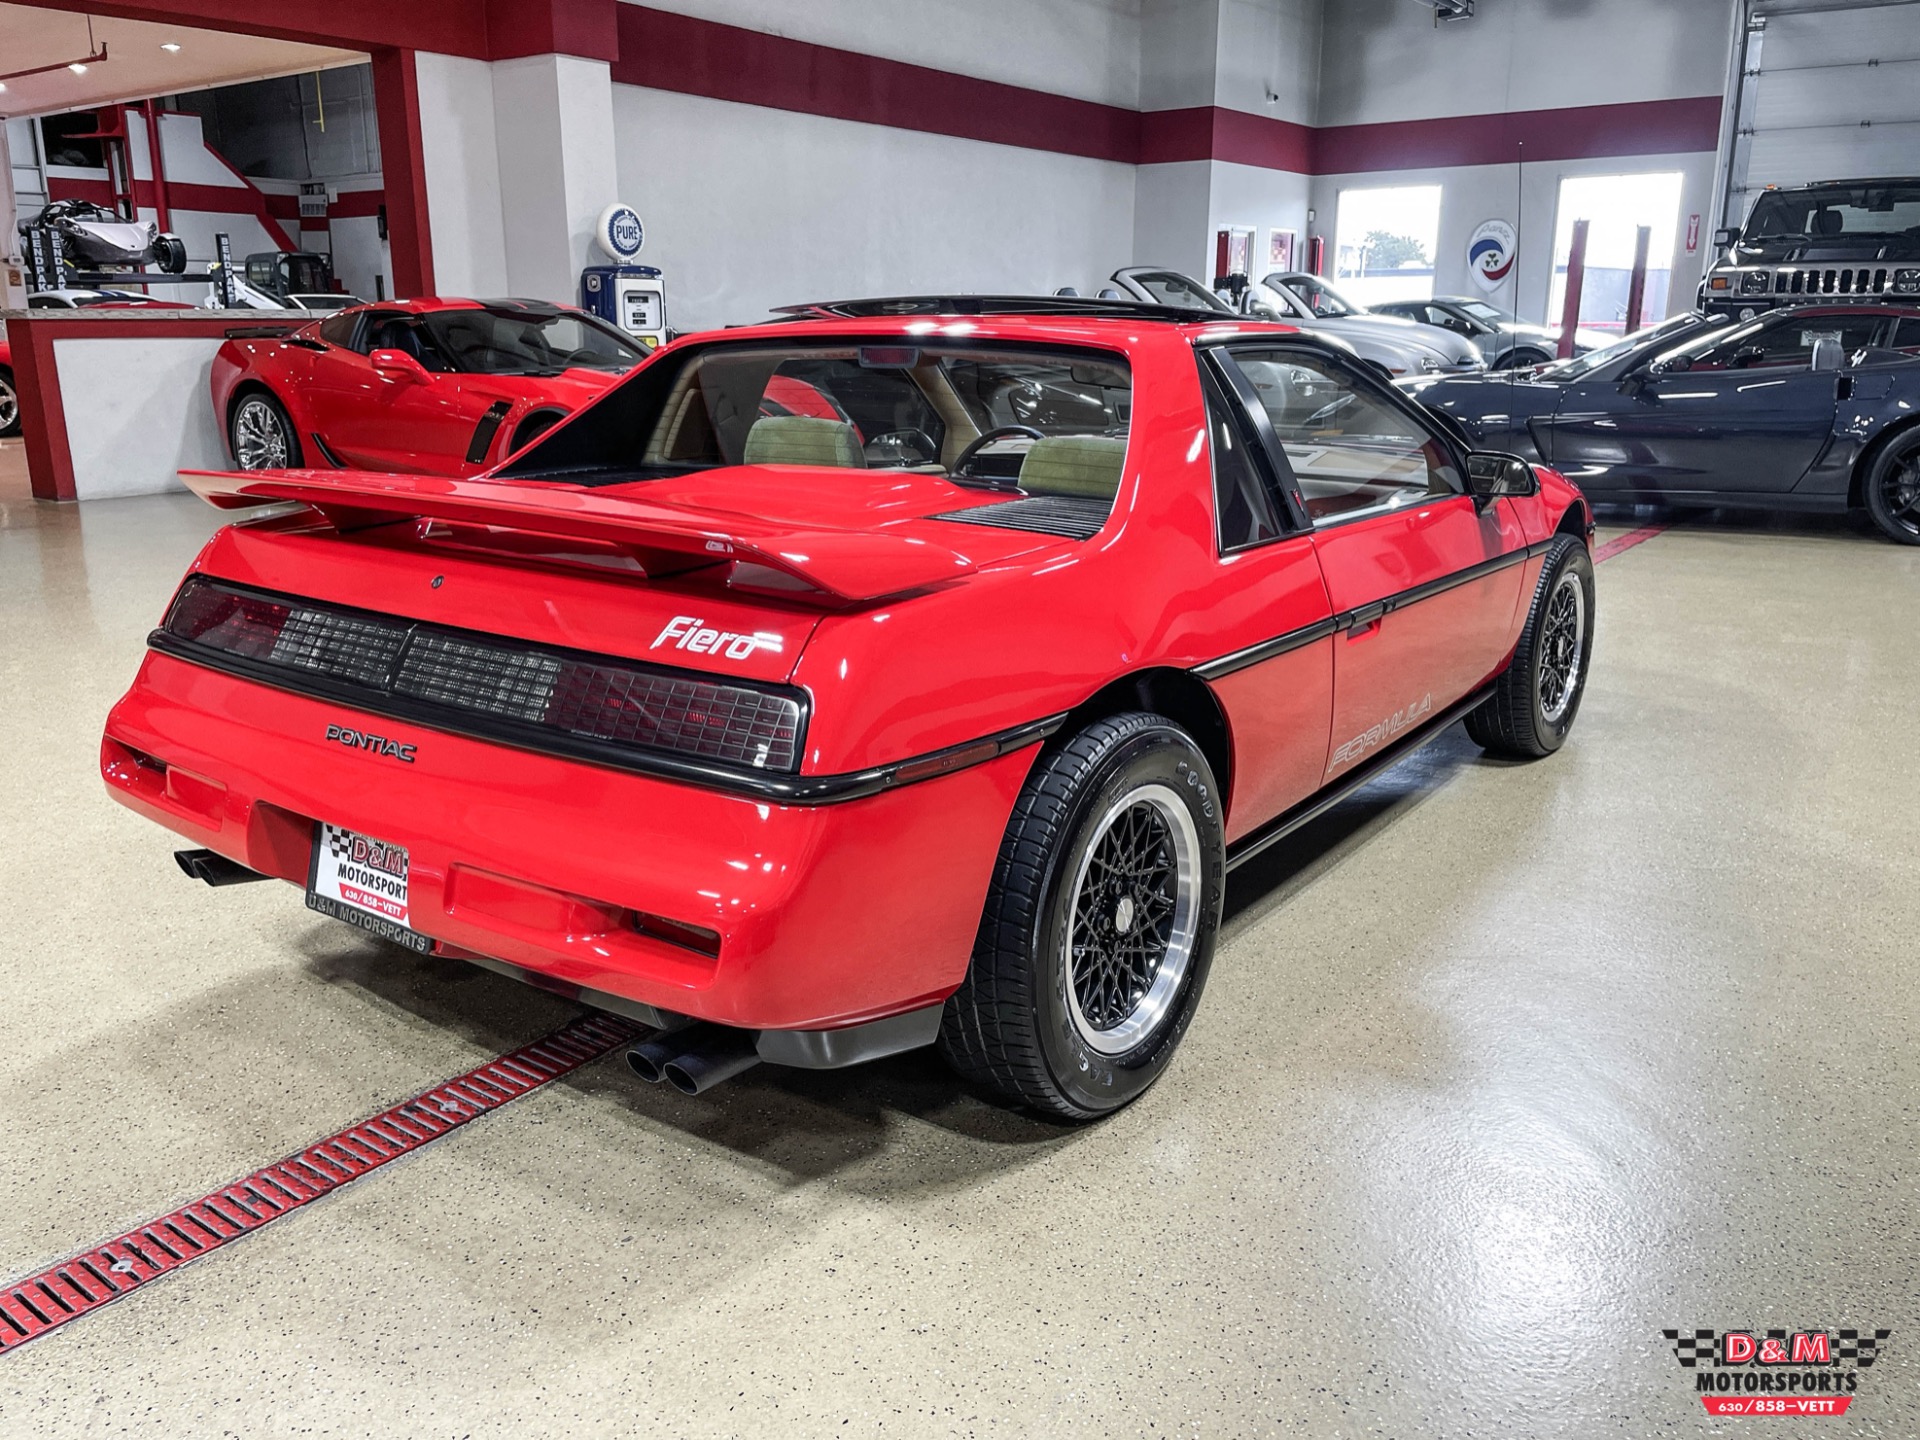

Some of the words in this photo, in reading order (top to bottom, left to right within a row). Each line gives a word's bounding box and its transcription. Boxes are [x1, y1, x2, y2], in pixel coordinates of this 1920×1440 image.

[616, 225, 638, 240] PURE
[31, 230, 47, 292] BENDPAK
[50, 230, 67, 291] BENDPAK
[221, 237, 235, 294] BENDPAK
[649, 615, 755, 660] Fiero
[325, 724, 418, 764] PONTIAC
[1328, 691, 1431, 773] FORMULA
[352, 836, 405, 878] D&M
[308, 894, 337, 916] D&M
[339, 906, 426, 951] MOTORSPORTS
[344, 889, 402, 917] 630/858-VETT
